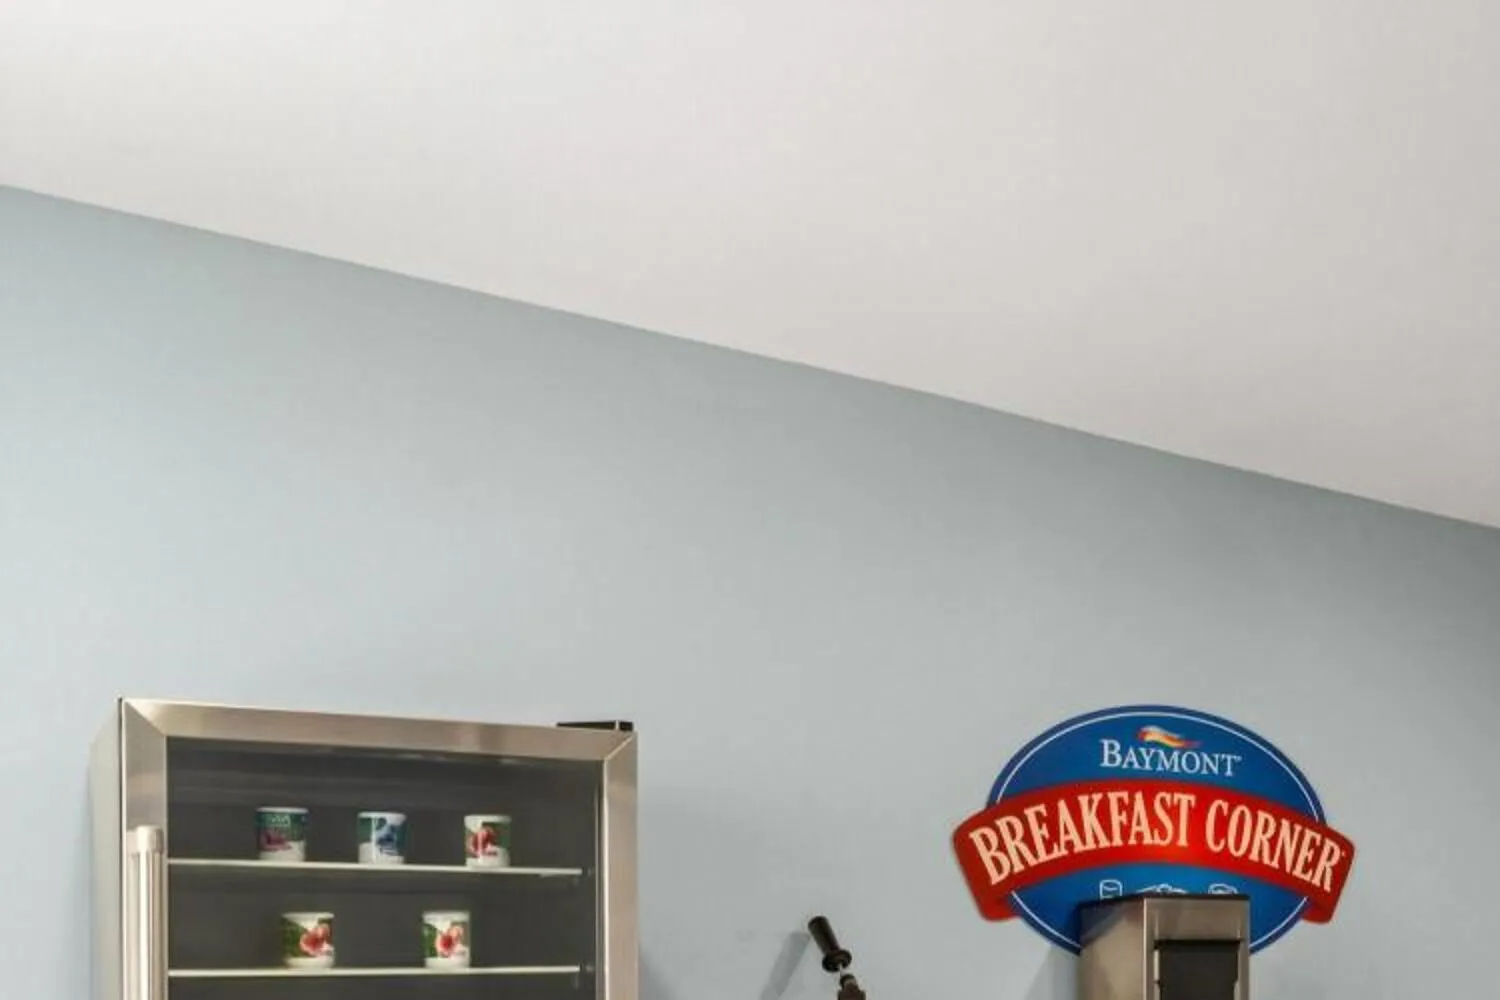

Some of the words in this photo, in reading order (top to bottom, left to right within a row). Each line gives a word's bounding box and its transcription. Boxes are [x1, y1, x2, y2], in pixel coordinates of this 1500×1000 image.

[1100, 739, 1236, 777] BAYMONT
[968, 790, 1196, 886] BREAKFAST
[1204, 798, 1343, 893] CORNER
